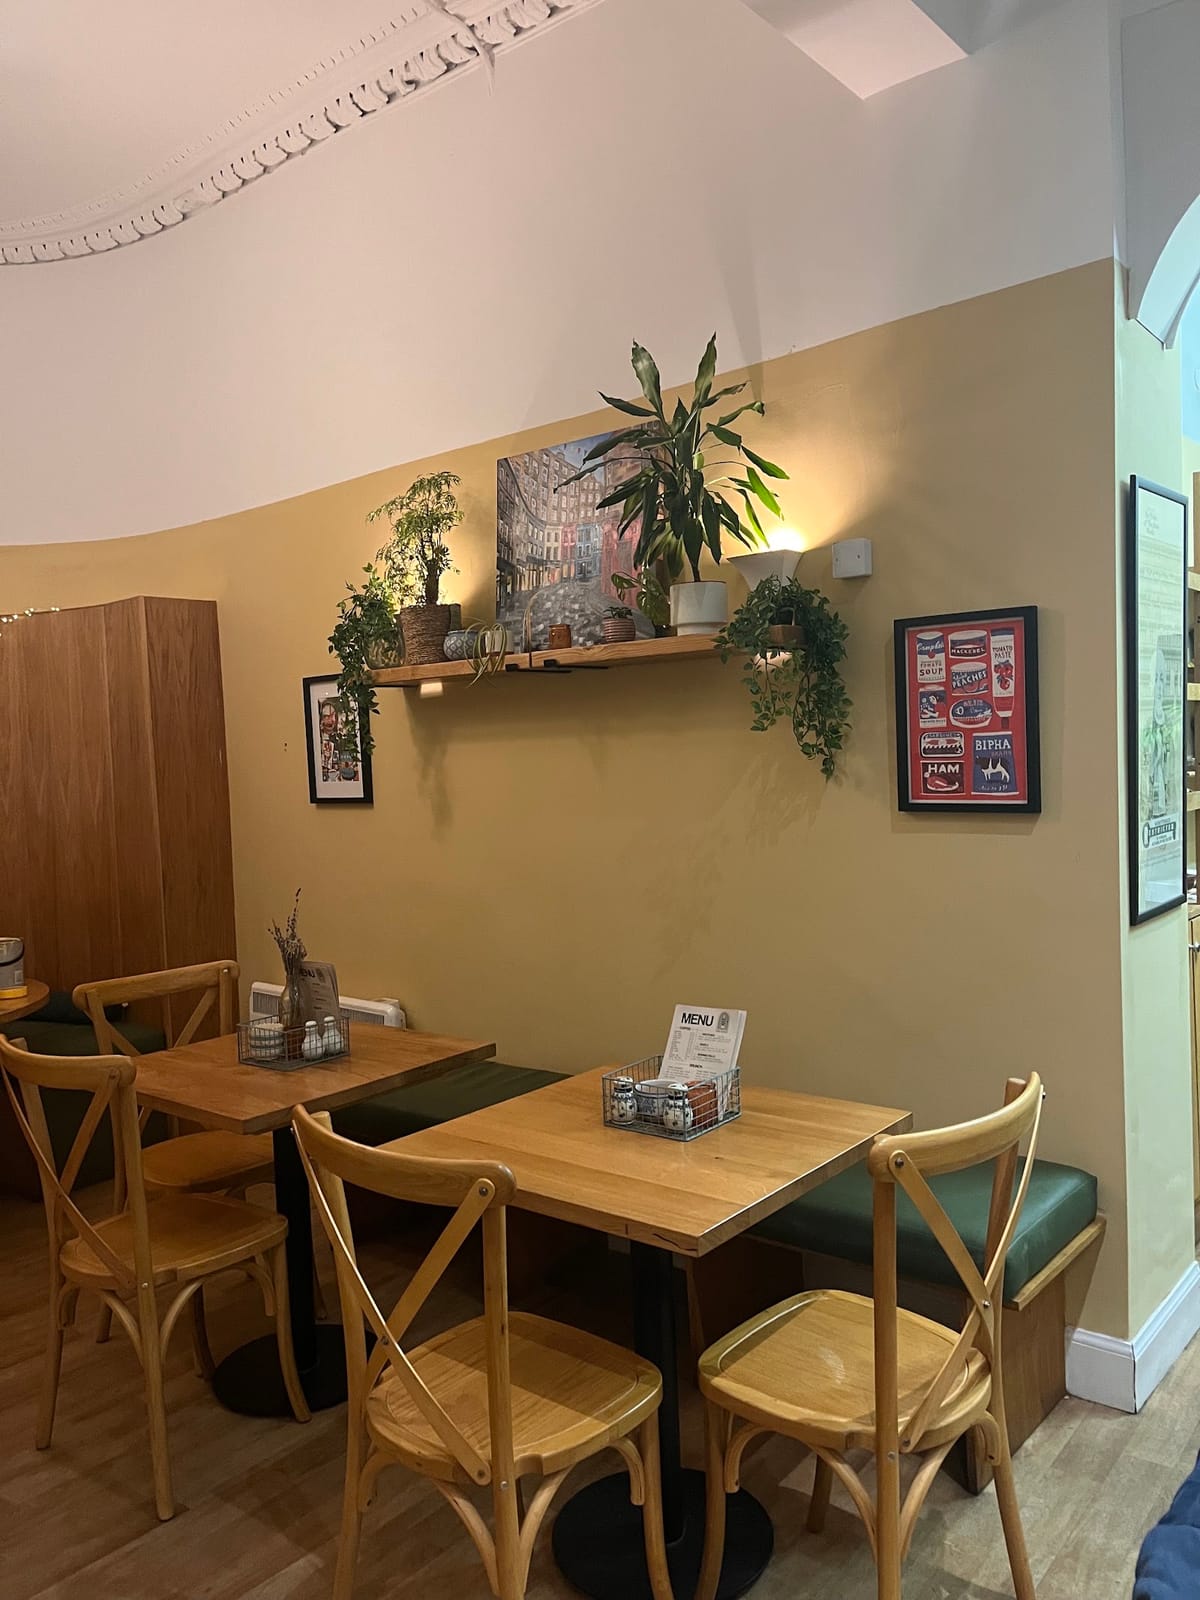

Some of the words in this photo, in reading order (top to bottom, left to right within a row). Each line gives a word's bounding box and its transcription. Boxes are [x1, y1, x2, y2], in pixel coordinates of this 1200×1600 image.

[993, 645, 1013, 653] TOMATO
[994, 652, 1012, 660] PASTE
[919, 668, 943, 677] SOUP
[952, 670, 987, 690] PEACHES
[975, 738, 1011, 751] BIPHA
[928, 763, 960, 774] HAM
[681, 1012, 715, 1027] MENU
